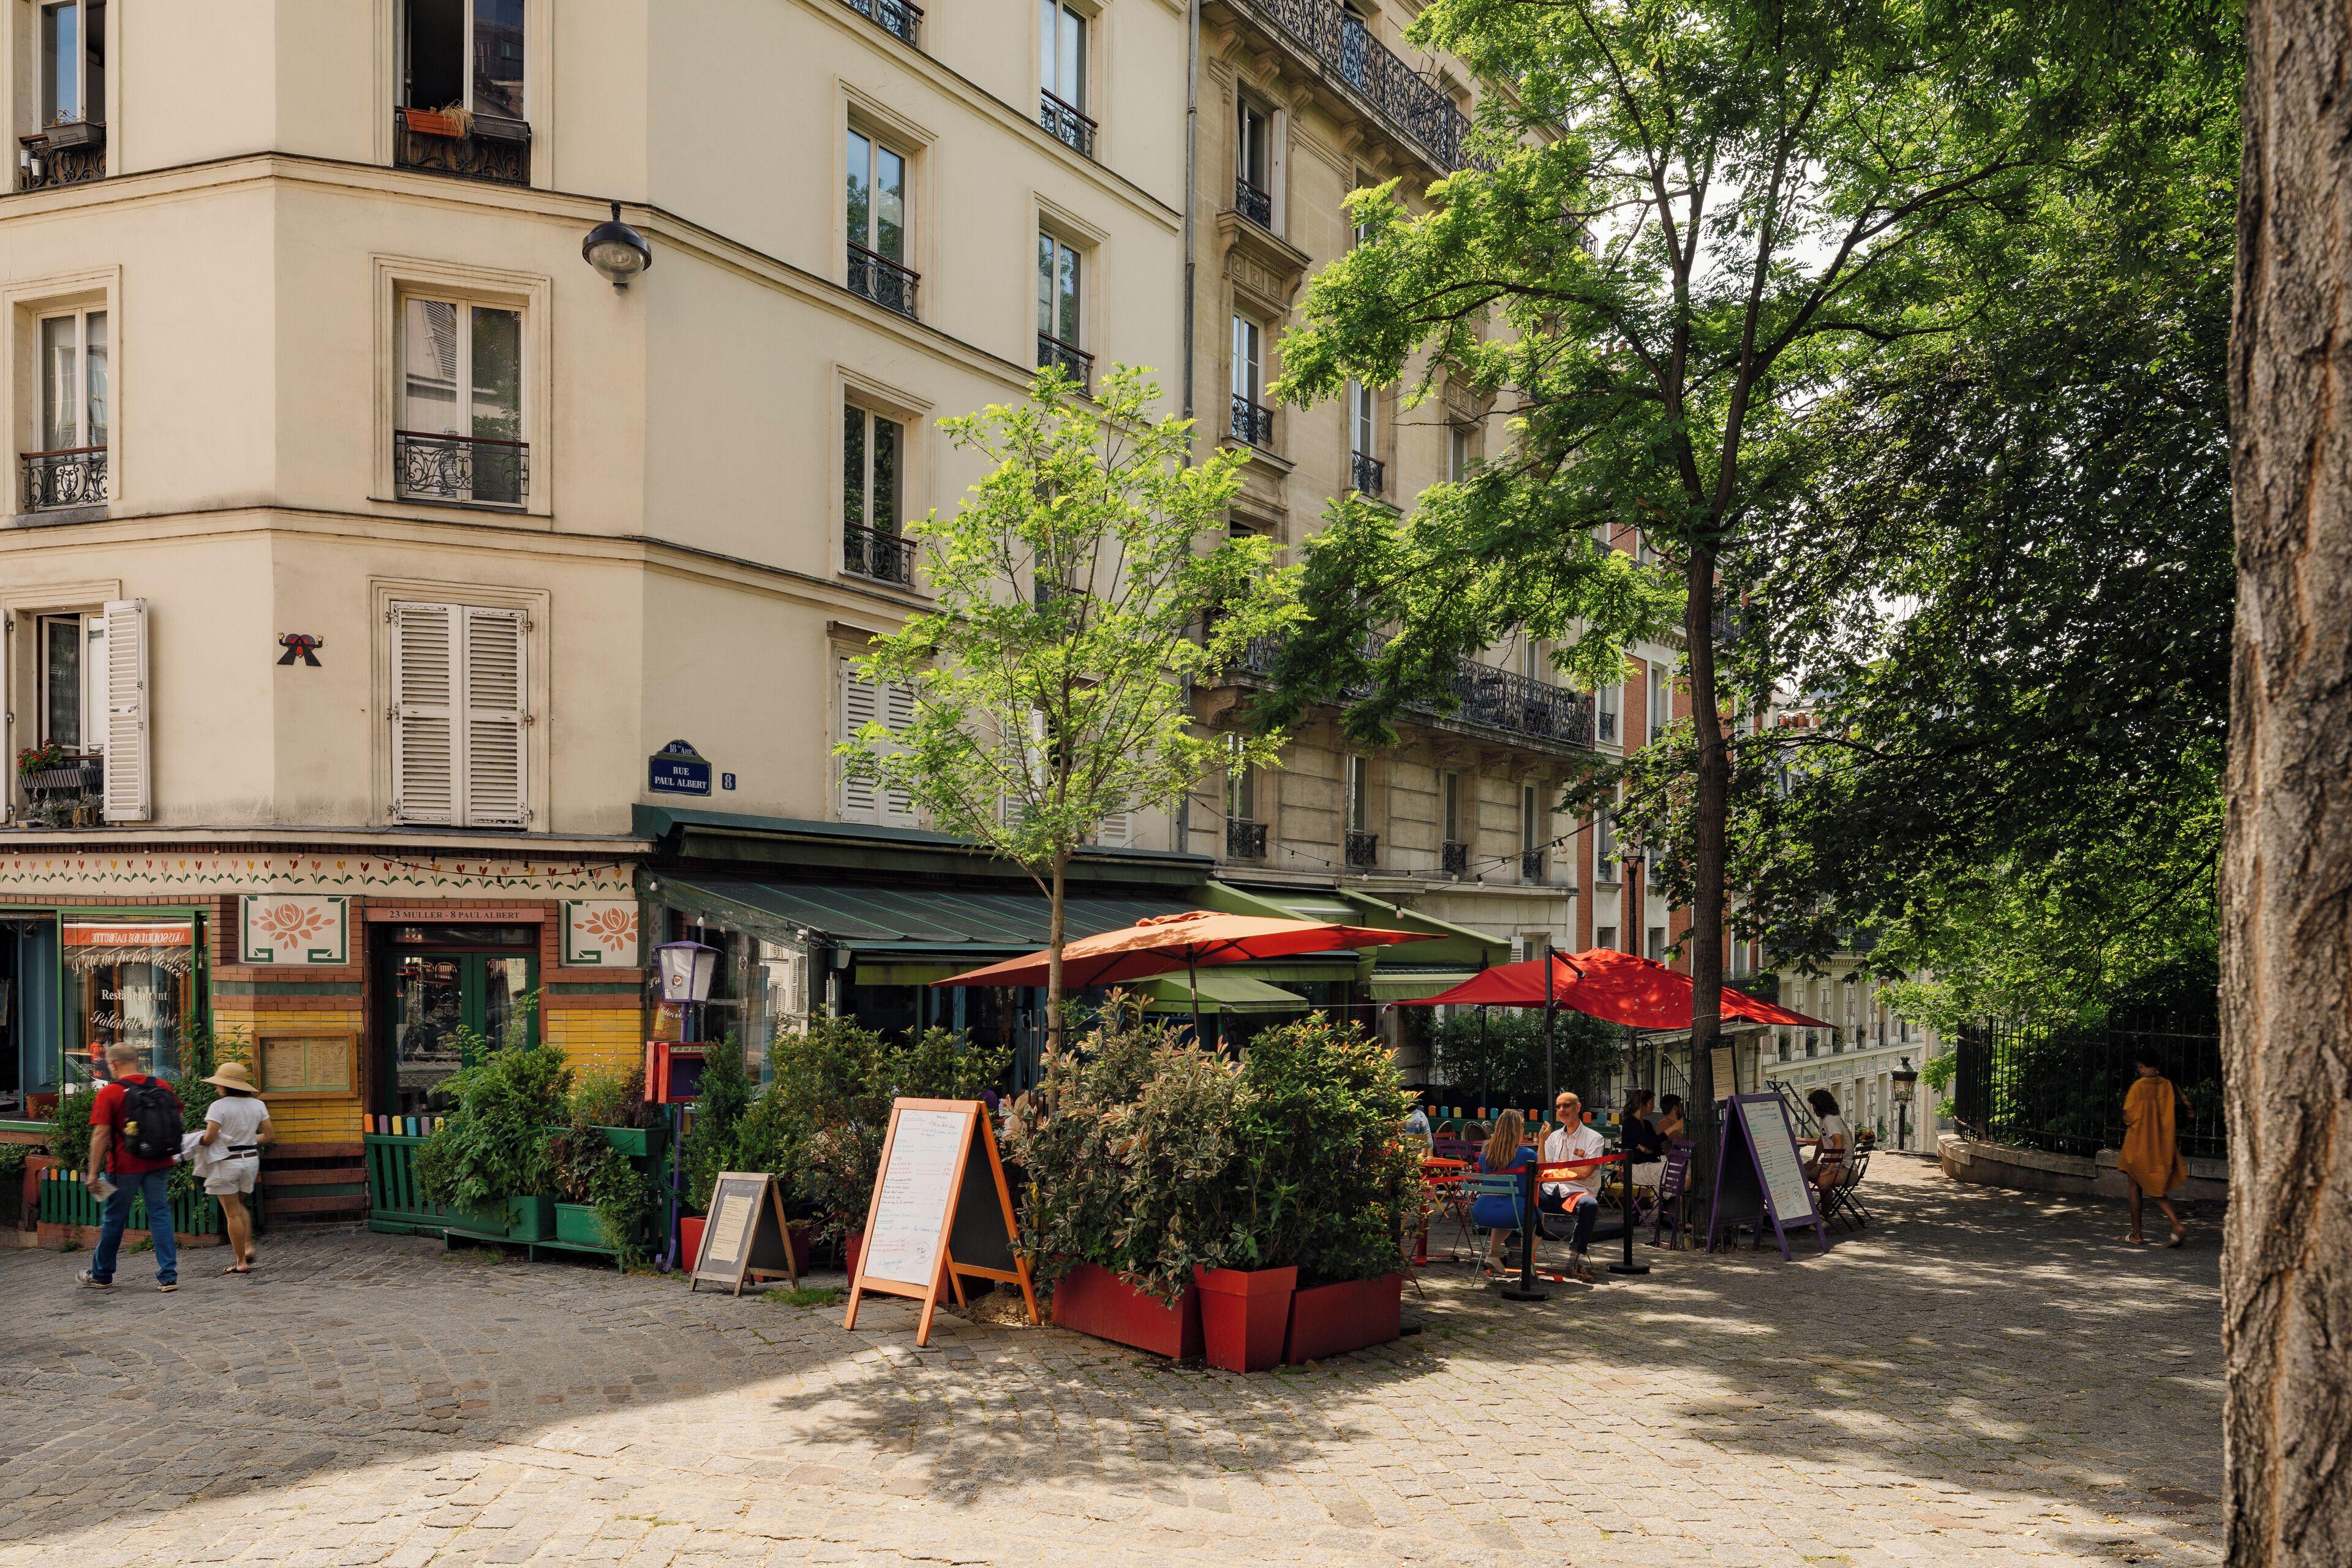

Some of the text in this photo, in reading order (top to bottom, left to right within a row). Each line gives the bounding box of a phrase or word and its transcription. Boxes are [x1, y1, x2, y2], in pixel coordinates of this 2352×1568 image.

[673, 766, 689, 775] RUE
[655, 776, 707, 789] PAUL ALBERT
[725, 774, 733, 789] 8
[116, 949, 150, 967] pente
[153, 955, 184, 979] douce
[102, 989, 154, 1001] Restaurant
[90, 1010, 124, 1030] Salon
